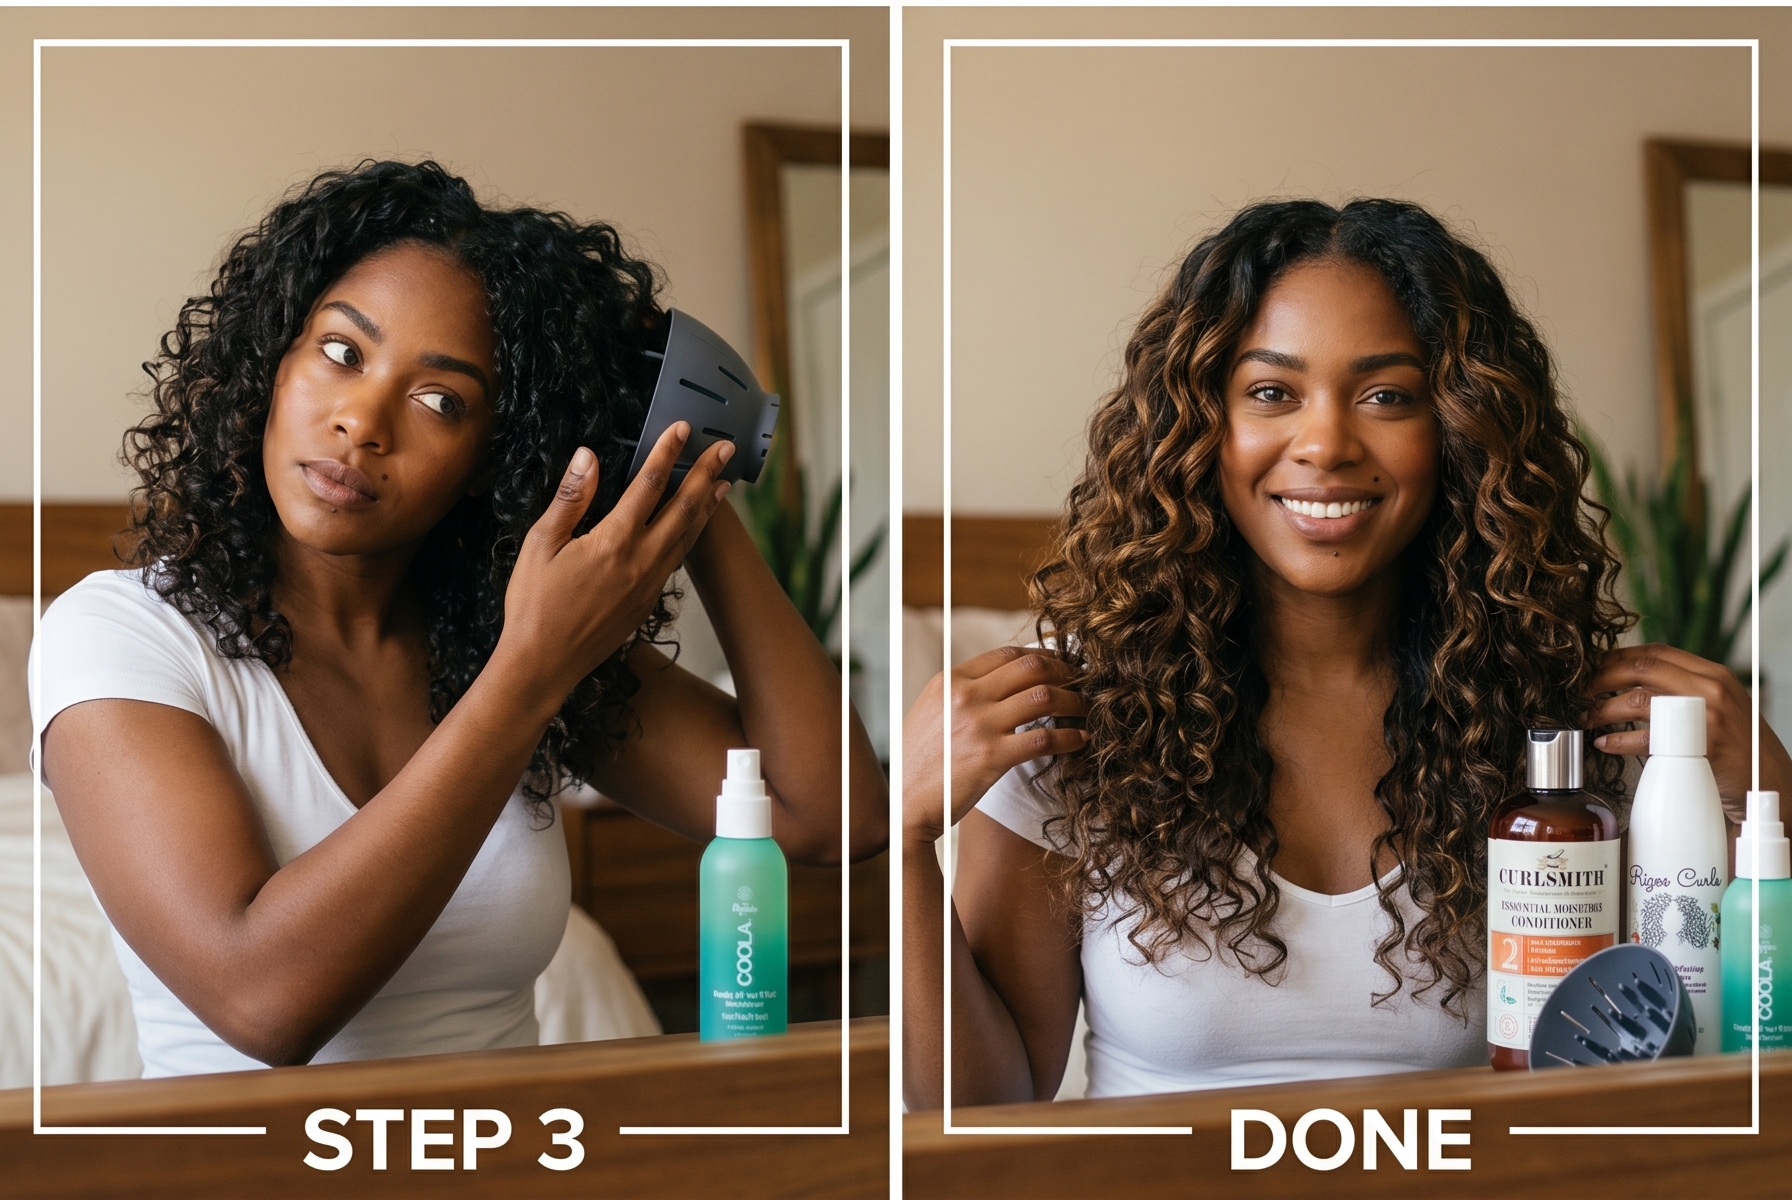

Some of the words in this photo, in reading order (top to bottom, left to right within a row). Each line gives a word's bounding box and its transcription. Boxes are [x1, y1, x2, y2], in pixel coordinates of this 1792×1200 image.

[1499, 868, 1604, 887] CURLSMITH
[1511, 916, 1593, 930] CONDITIONER
[736, 921, 753, 987] COOLA
[1501, 937, 1519, 971] 2
[1758, 960, 1773, 1021] COOLA
